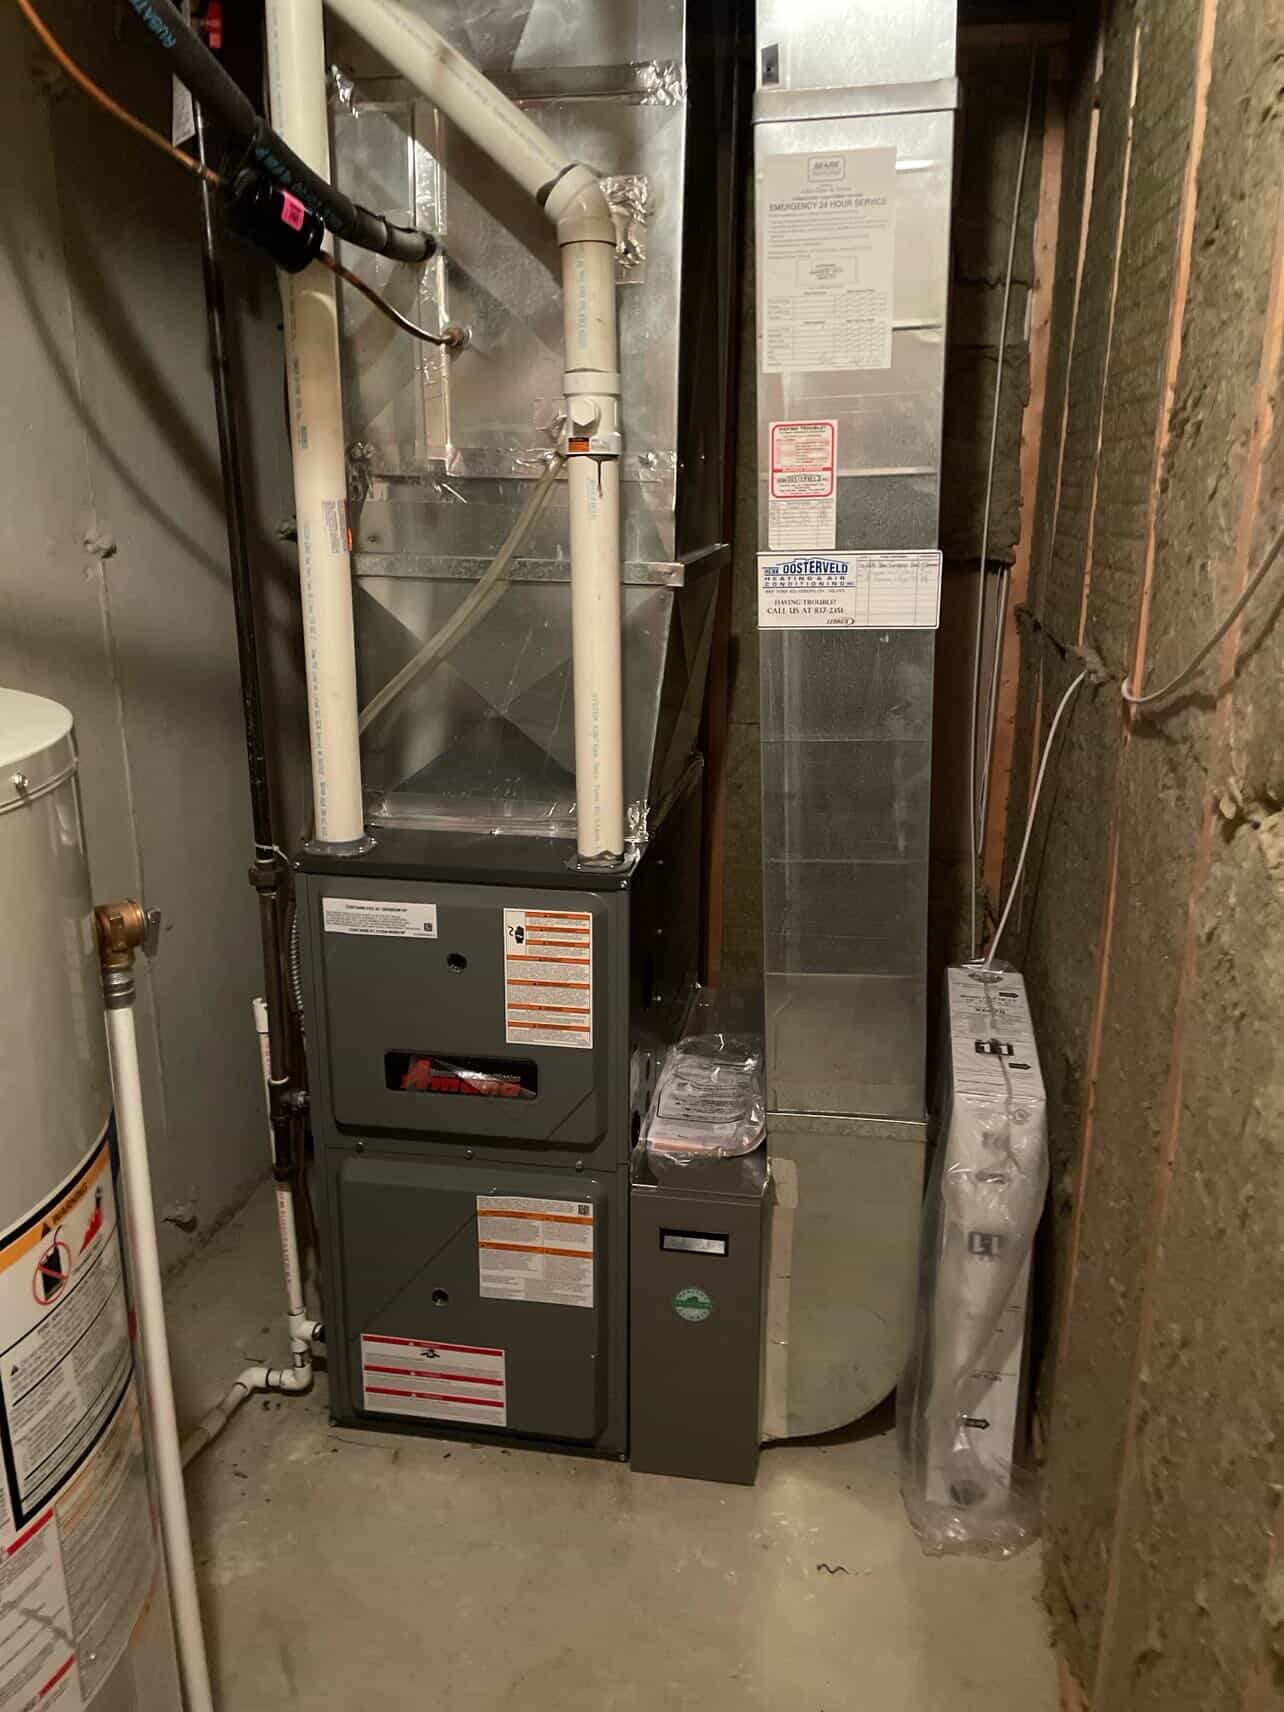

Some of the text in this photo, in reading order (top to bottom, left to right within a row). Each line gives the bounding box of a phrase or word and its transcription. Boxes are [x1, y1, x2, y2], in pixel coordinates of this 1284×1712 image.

[769, 200, 817, 212] EMERGENCY
[830, 199, 853, 209] HOUR
[854, 197, 888, 208] SERVICE
[783, 560, 848, 574] OOSTERVELD
[767, 607, 786, 615] CALL
